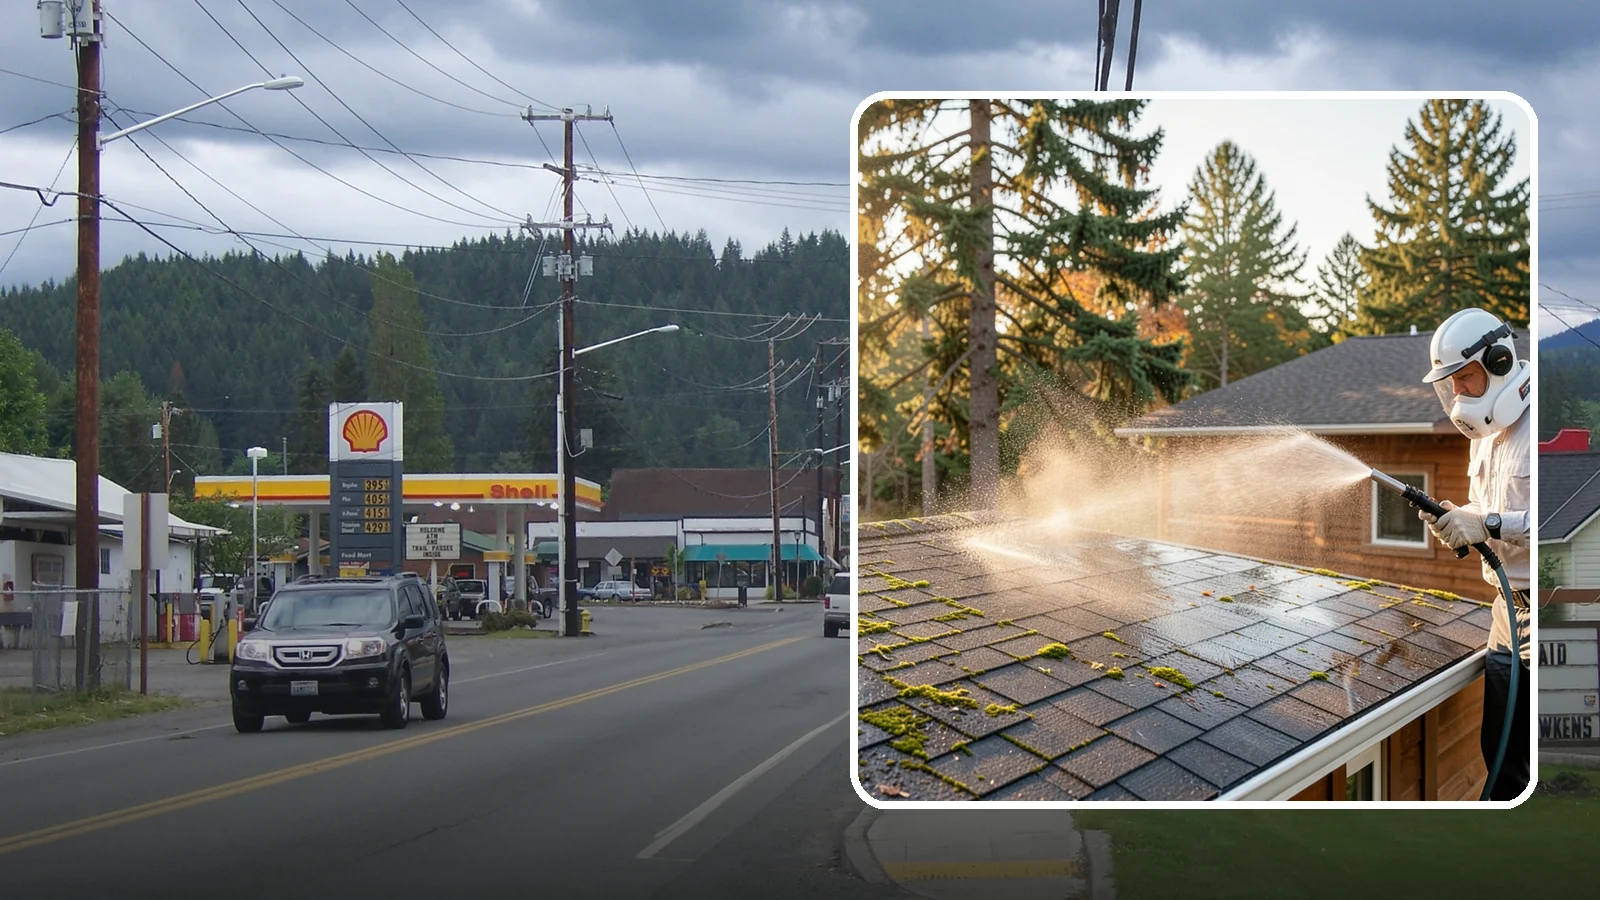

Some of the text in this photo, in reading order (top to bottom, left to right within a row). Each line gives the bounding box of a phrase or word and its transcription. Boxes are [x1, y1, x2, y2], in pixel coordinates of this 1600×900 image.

[366, 480, 383, 490] 395
[490, 484, 547, 499] Shell
[366, 494, 383, 504] 405
[366, 508, 383, 518] 415
[366, 522, 383, 532] 429
